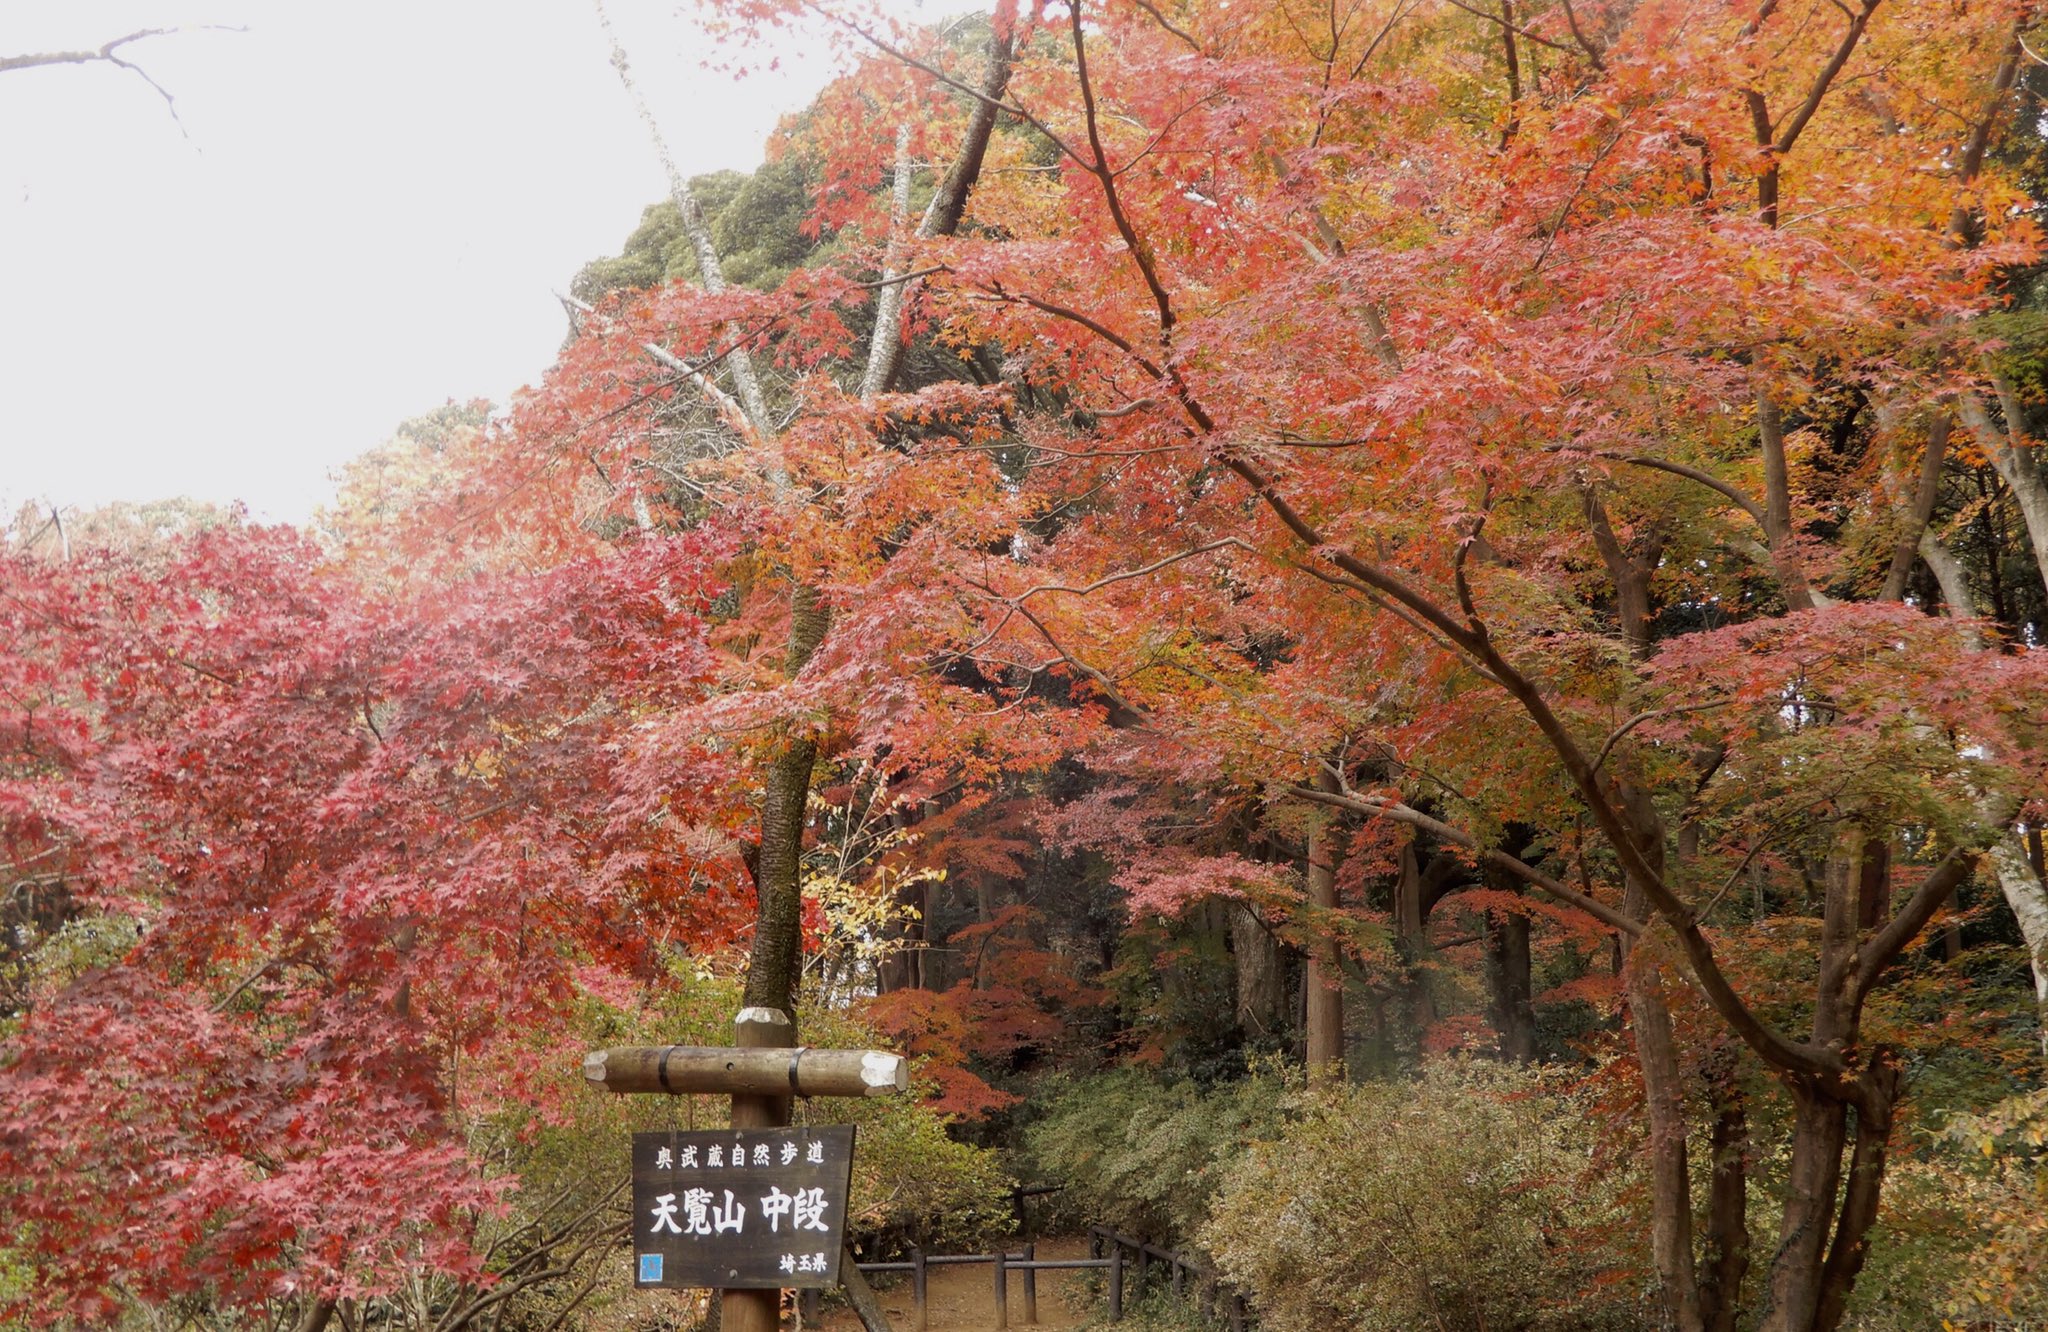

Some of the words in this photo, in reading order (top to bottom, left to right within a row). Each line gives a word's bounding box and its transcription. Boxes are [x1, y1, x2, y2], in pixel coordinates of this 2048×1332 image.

[656, 1141, 824, 1169] 奥武蔵自然歩道
[651, 1187, 745, 1235] 天覧山
[760, 1186, 829, 1233] 中段
[779, 1253, 827, 1274] 埼玉県
